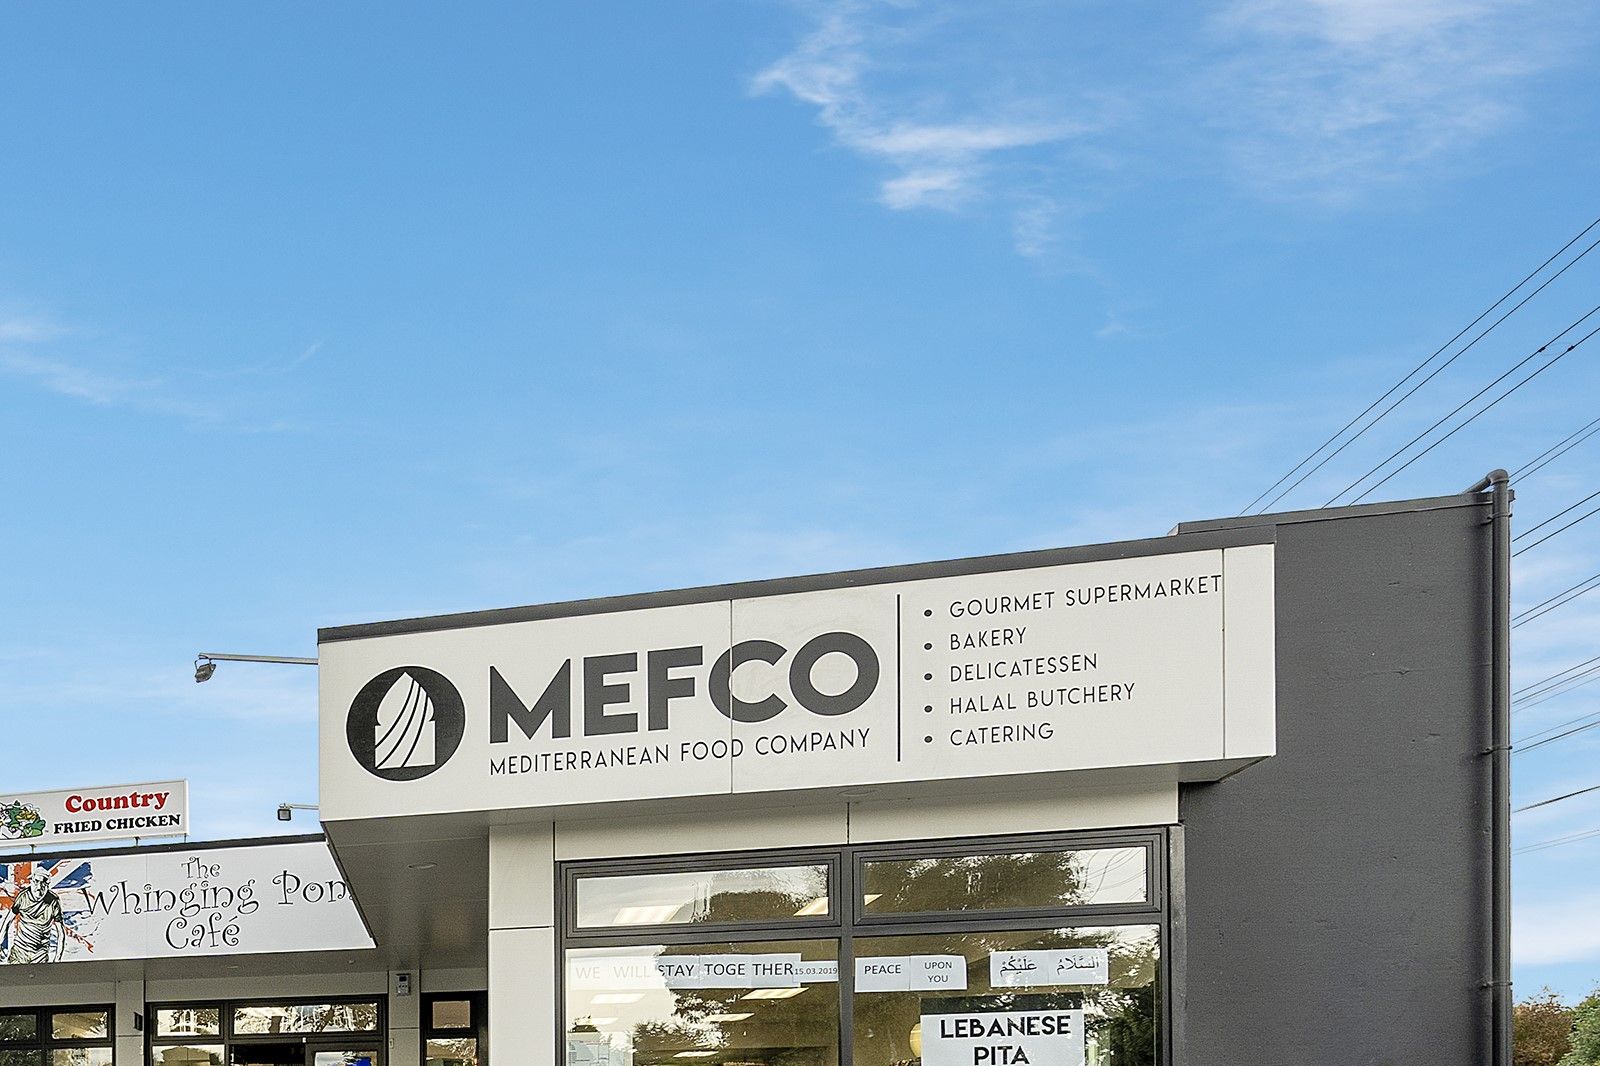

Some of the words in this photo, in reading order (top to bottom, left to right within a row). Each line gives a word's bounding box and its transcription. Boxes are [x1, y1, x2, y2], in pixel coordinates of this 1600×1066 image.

[949, 591, 1056, 618] GOURMET
[1065, 574, 1222, 607] SUPERMARKET
[949, 626, 1027, 651] BAKERY
[950, 653, 1098, 682] DELICATESSEN
[489, 631, 880, 744] MEFCO
[950, 693, 1017, 715] HALAL
[1027, 682, 1136, 709] BUTCHERY
[949, 722, 1054, 746] CATERING
[489, 744, 669, 776] MEDITERRANEAN
[680, 738, 744, 763] FOOD
[755, 728, 871, 756] COMPANY
[65, 791, 170, 813] Country
[53, 819, 102, 834] FRIED
[105, 814, 181, 831] CHICKEN
[180, 856, 221, 879] The
[80, 879, 259, 917] Whinging
[165, 912, 241, 949] Café
[575, 966, 601, 979] WE
[613, 965, 651, 979] WILL
[657, 963, 696, 977] STAY
[794, 966, 838, 975] 15.03.2019
[864, 963, 901, 975] PEACE
[924, 961, 953, 970] UPON
[928, 974, 949, 983] YOU
[940, 1015, 1071, 1038] LEBANESE
[973, 1045, 1030, 1066] PITA
